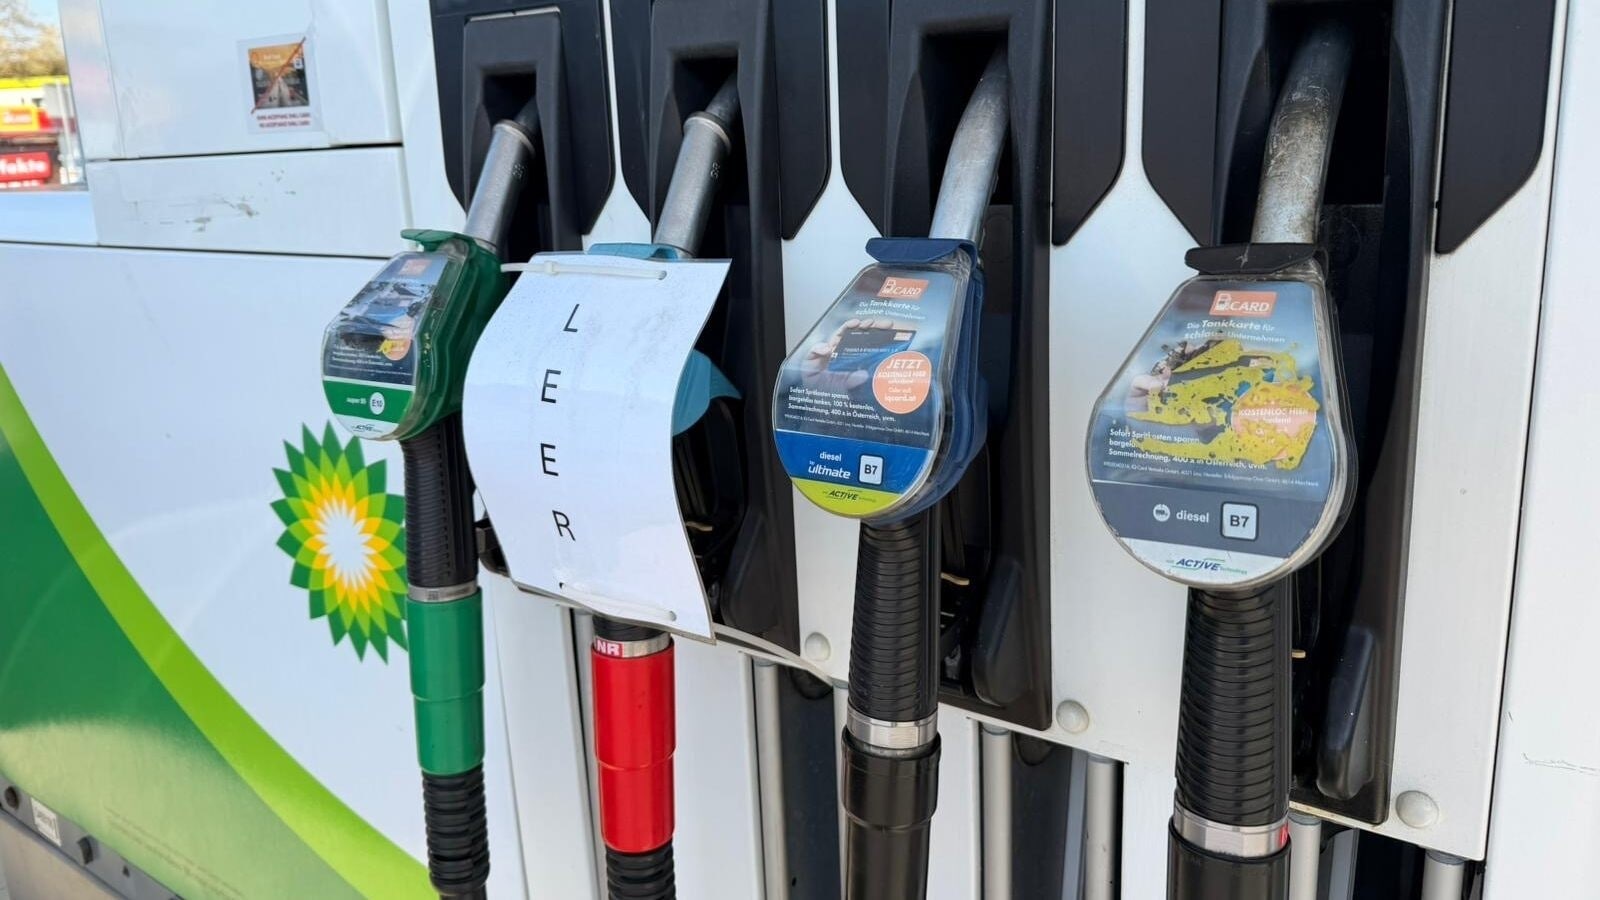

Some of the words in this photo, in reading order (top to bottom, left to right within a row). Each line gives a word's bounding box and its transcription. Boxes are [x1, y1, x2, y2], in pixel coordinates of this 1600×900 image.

[1230, 301, 1270, 312] CARD
[1201, 319, 1262, 331] Tankkarte
[1262, 323, 1276, 332] für
[886, 359, 924, 369] JETZT
[789, 386, 805, 394] Sofort
[805, 387, 831, 397] Spritkosten
[852, 410, 881, 421] Österreich,
[1239, 407, 1288, 417] KOSTENLOS
[541, 303, 580, 542] LEER
[1109, 428, 1131, 438] Sofort
[819, 451, 842, 462] diesel
[1108, 448, 1171, 464] Sammelrechnung,
[1173, 455, 1189, 463] 400
[808, 463, 851, 479] ultimate
[864, 464, 878, 475] B7
[828, 489, 859, 501] ACTIVE
[1176, 510, 1210, 523] diesel
[1230, 515, 1250, 528] B7
[1176, 558, 1221, 572] ACTIVE
